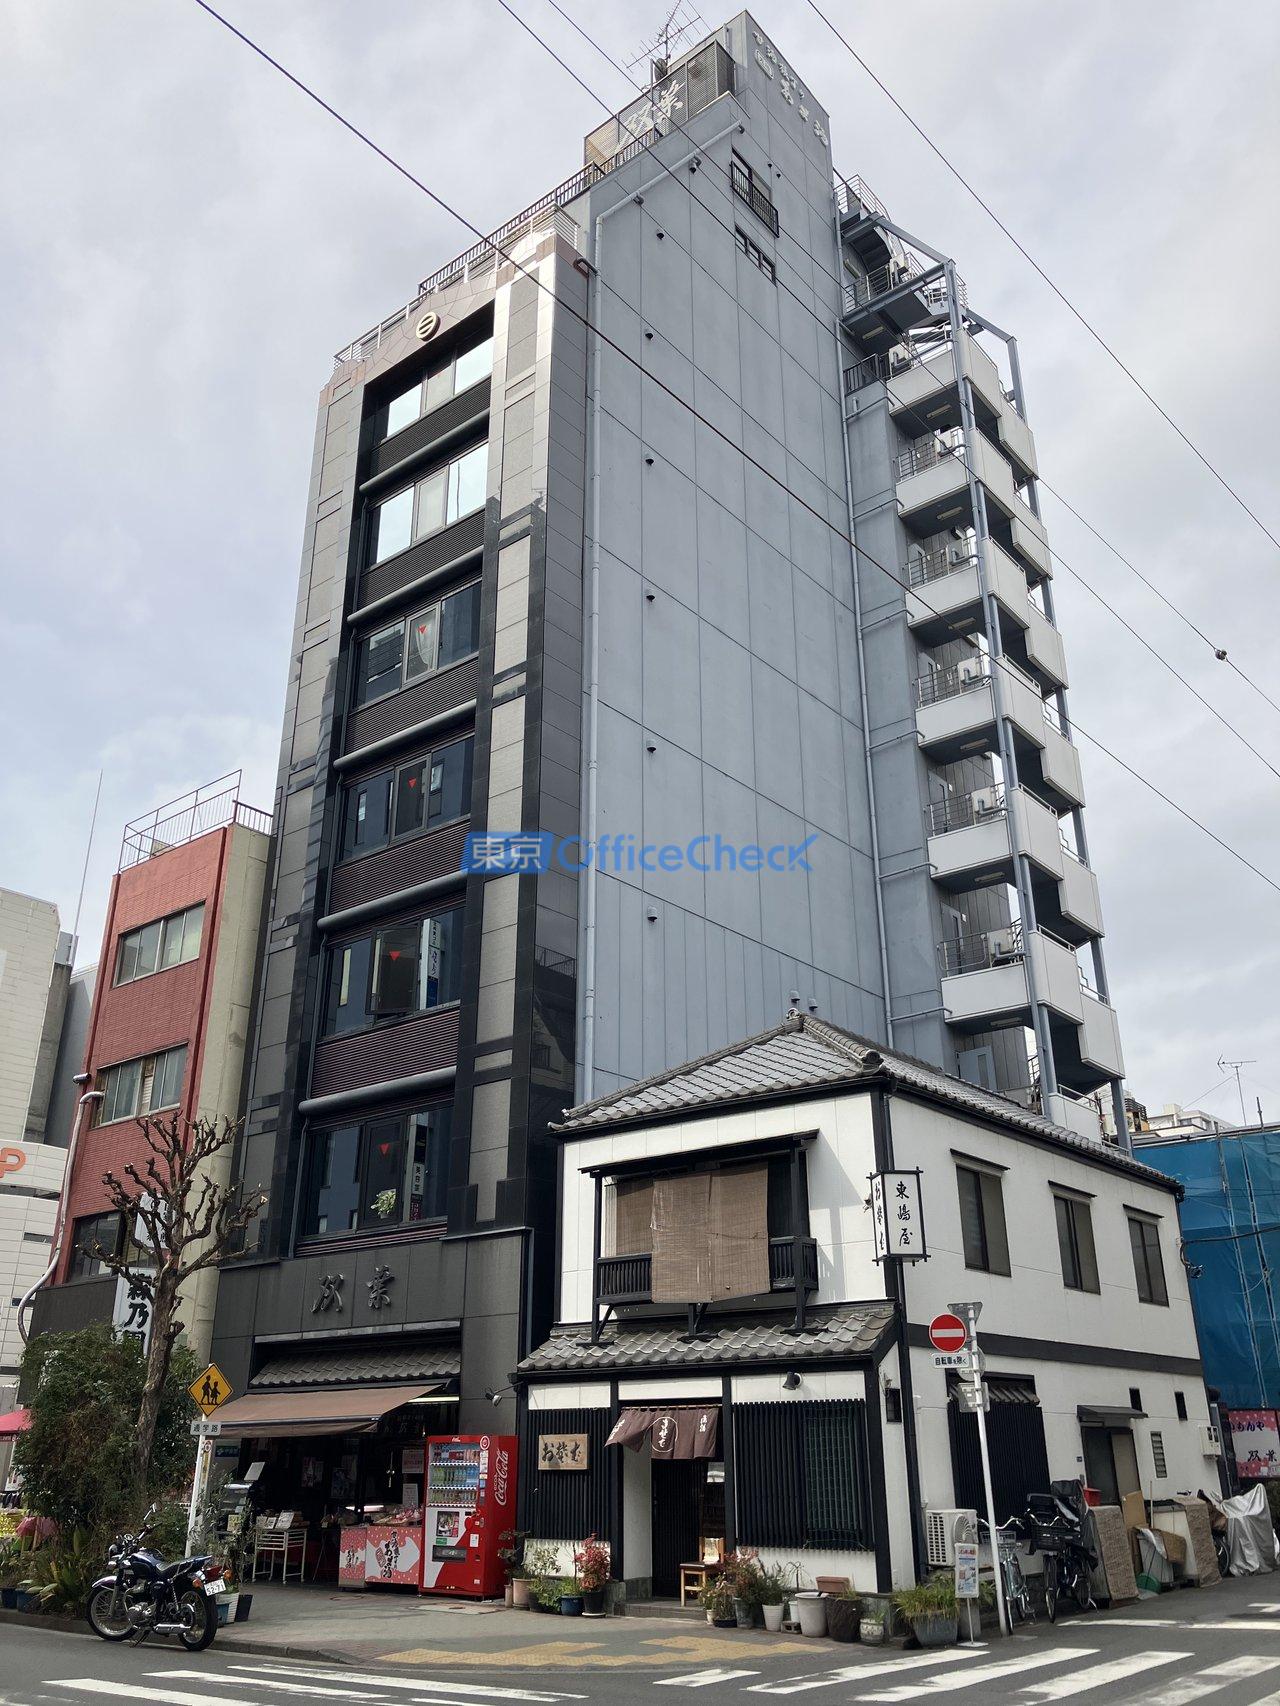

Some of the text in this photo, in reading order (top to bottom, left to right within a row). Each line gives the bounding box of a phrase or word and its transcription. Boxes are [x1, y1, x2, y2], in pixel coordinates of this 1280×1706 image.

[896, 1181, 913, 1246] 東嶋屋
[193, 1424, 219, 1433] 通学路
